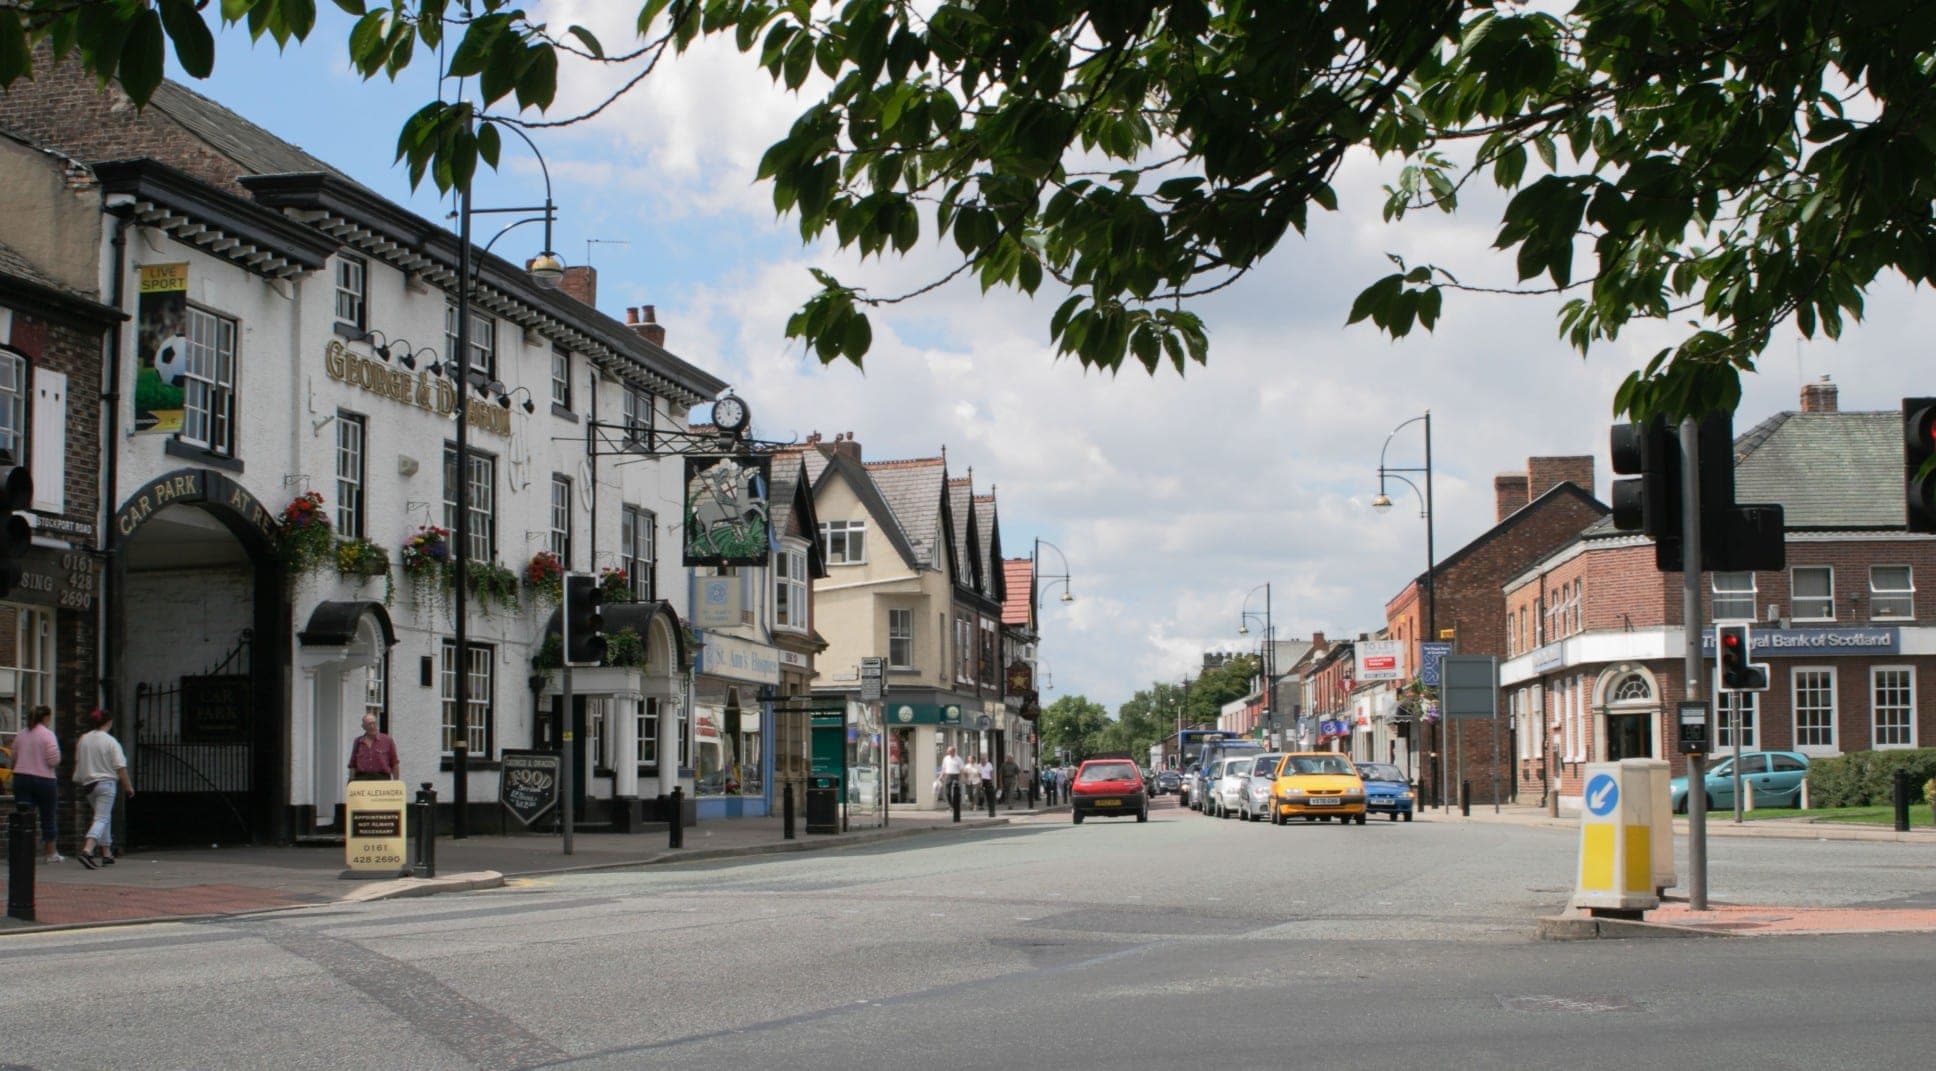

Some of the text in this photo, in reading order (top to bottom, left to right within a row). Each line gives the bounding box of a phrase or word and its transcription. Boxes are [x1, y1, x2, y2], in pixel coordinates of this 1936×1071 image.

[149, 267, 177, 278] LIVE
[142, 277, 185, 290] SPORT
[326, 339, 511, 437] GEORGE & DAGON
[119, 494, 152, 536] CAR
[154, 474, 197, 506] PARK
[230, 488, 251, 513] AT
[37, 516, 92, 535] STOCKPORT ROAD
[62, 553, 94, 573] 0161
[20, 572, 93, 592] SING 428
[60, 590, 92, 608] 2690
[1702, 632, 1891, 650] Th yal Bank of Scotland
[349, 788, 403, 798] JANE ALEXANDRA
[363, 844, 388, 852] 0161
[353, 855, 401, 864] 428 2690
